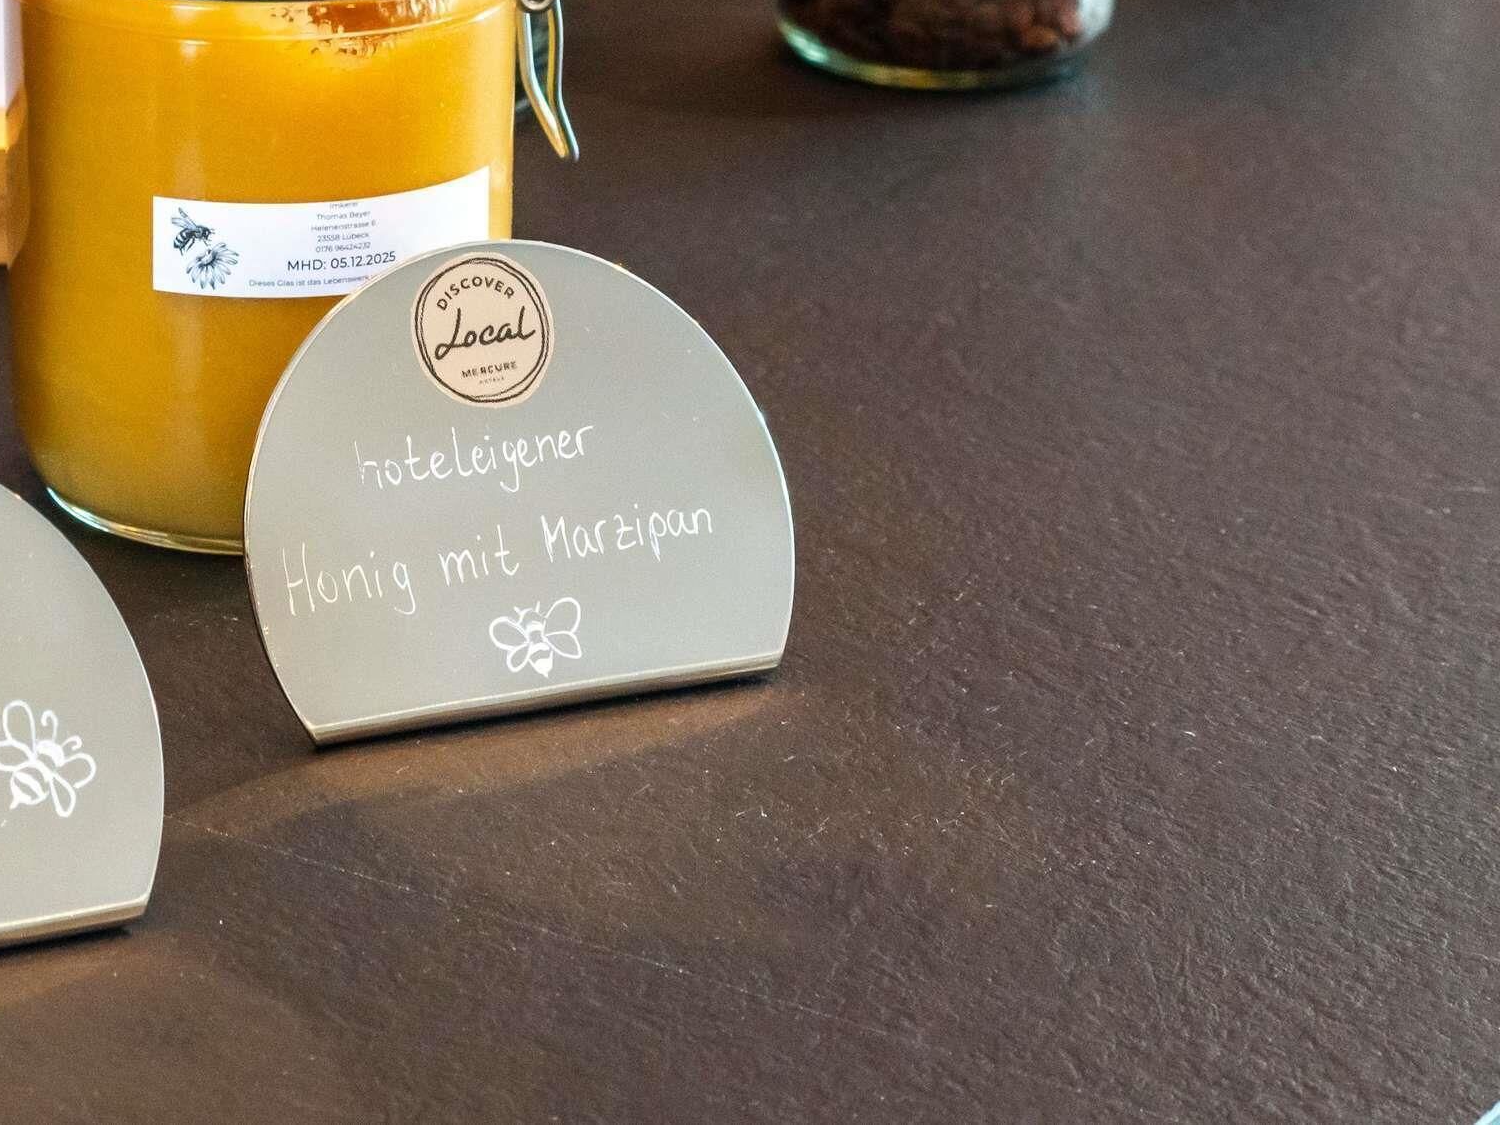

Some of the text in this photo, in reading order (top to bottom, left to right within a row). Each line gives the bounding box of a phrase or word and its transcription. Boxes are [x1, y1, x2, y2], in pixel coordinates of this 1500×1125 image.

[287, 250, 396, 272] MHD: 05.12.2025
[315, 244, 333, 253] 0176
[249, 279, 275, 288] Dieses
[277, 278, 295, 287] Glas
[295, 277, 305, 287] ist
[307, 277, 322, 286] das
[437, 276, 515, 311] DISCOVER
[435, 306, 536, 360] Local
[461, 361, 518, 379] MERCURE
[354, 425, 594, 493] hoteleigener
[283, 504, 713, 615] Honig mit Marzipan
